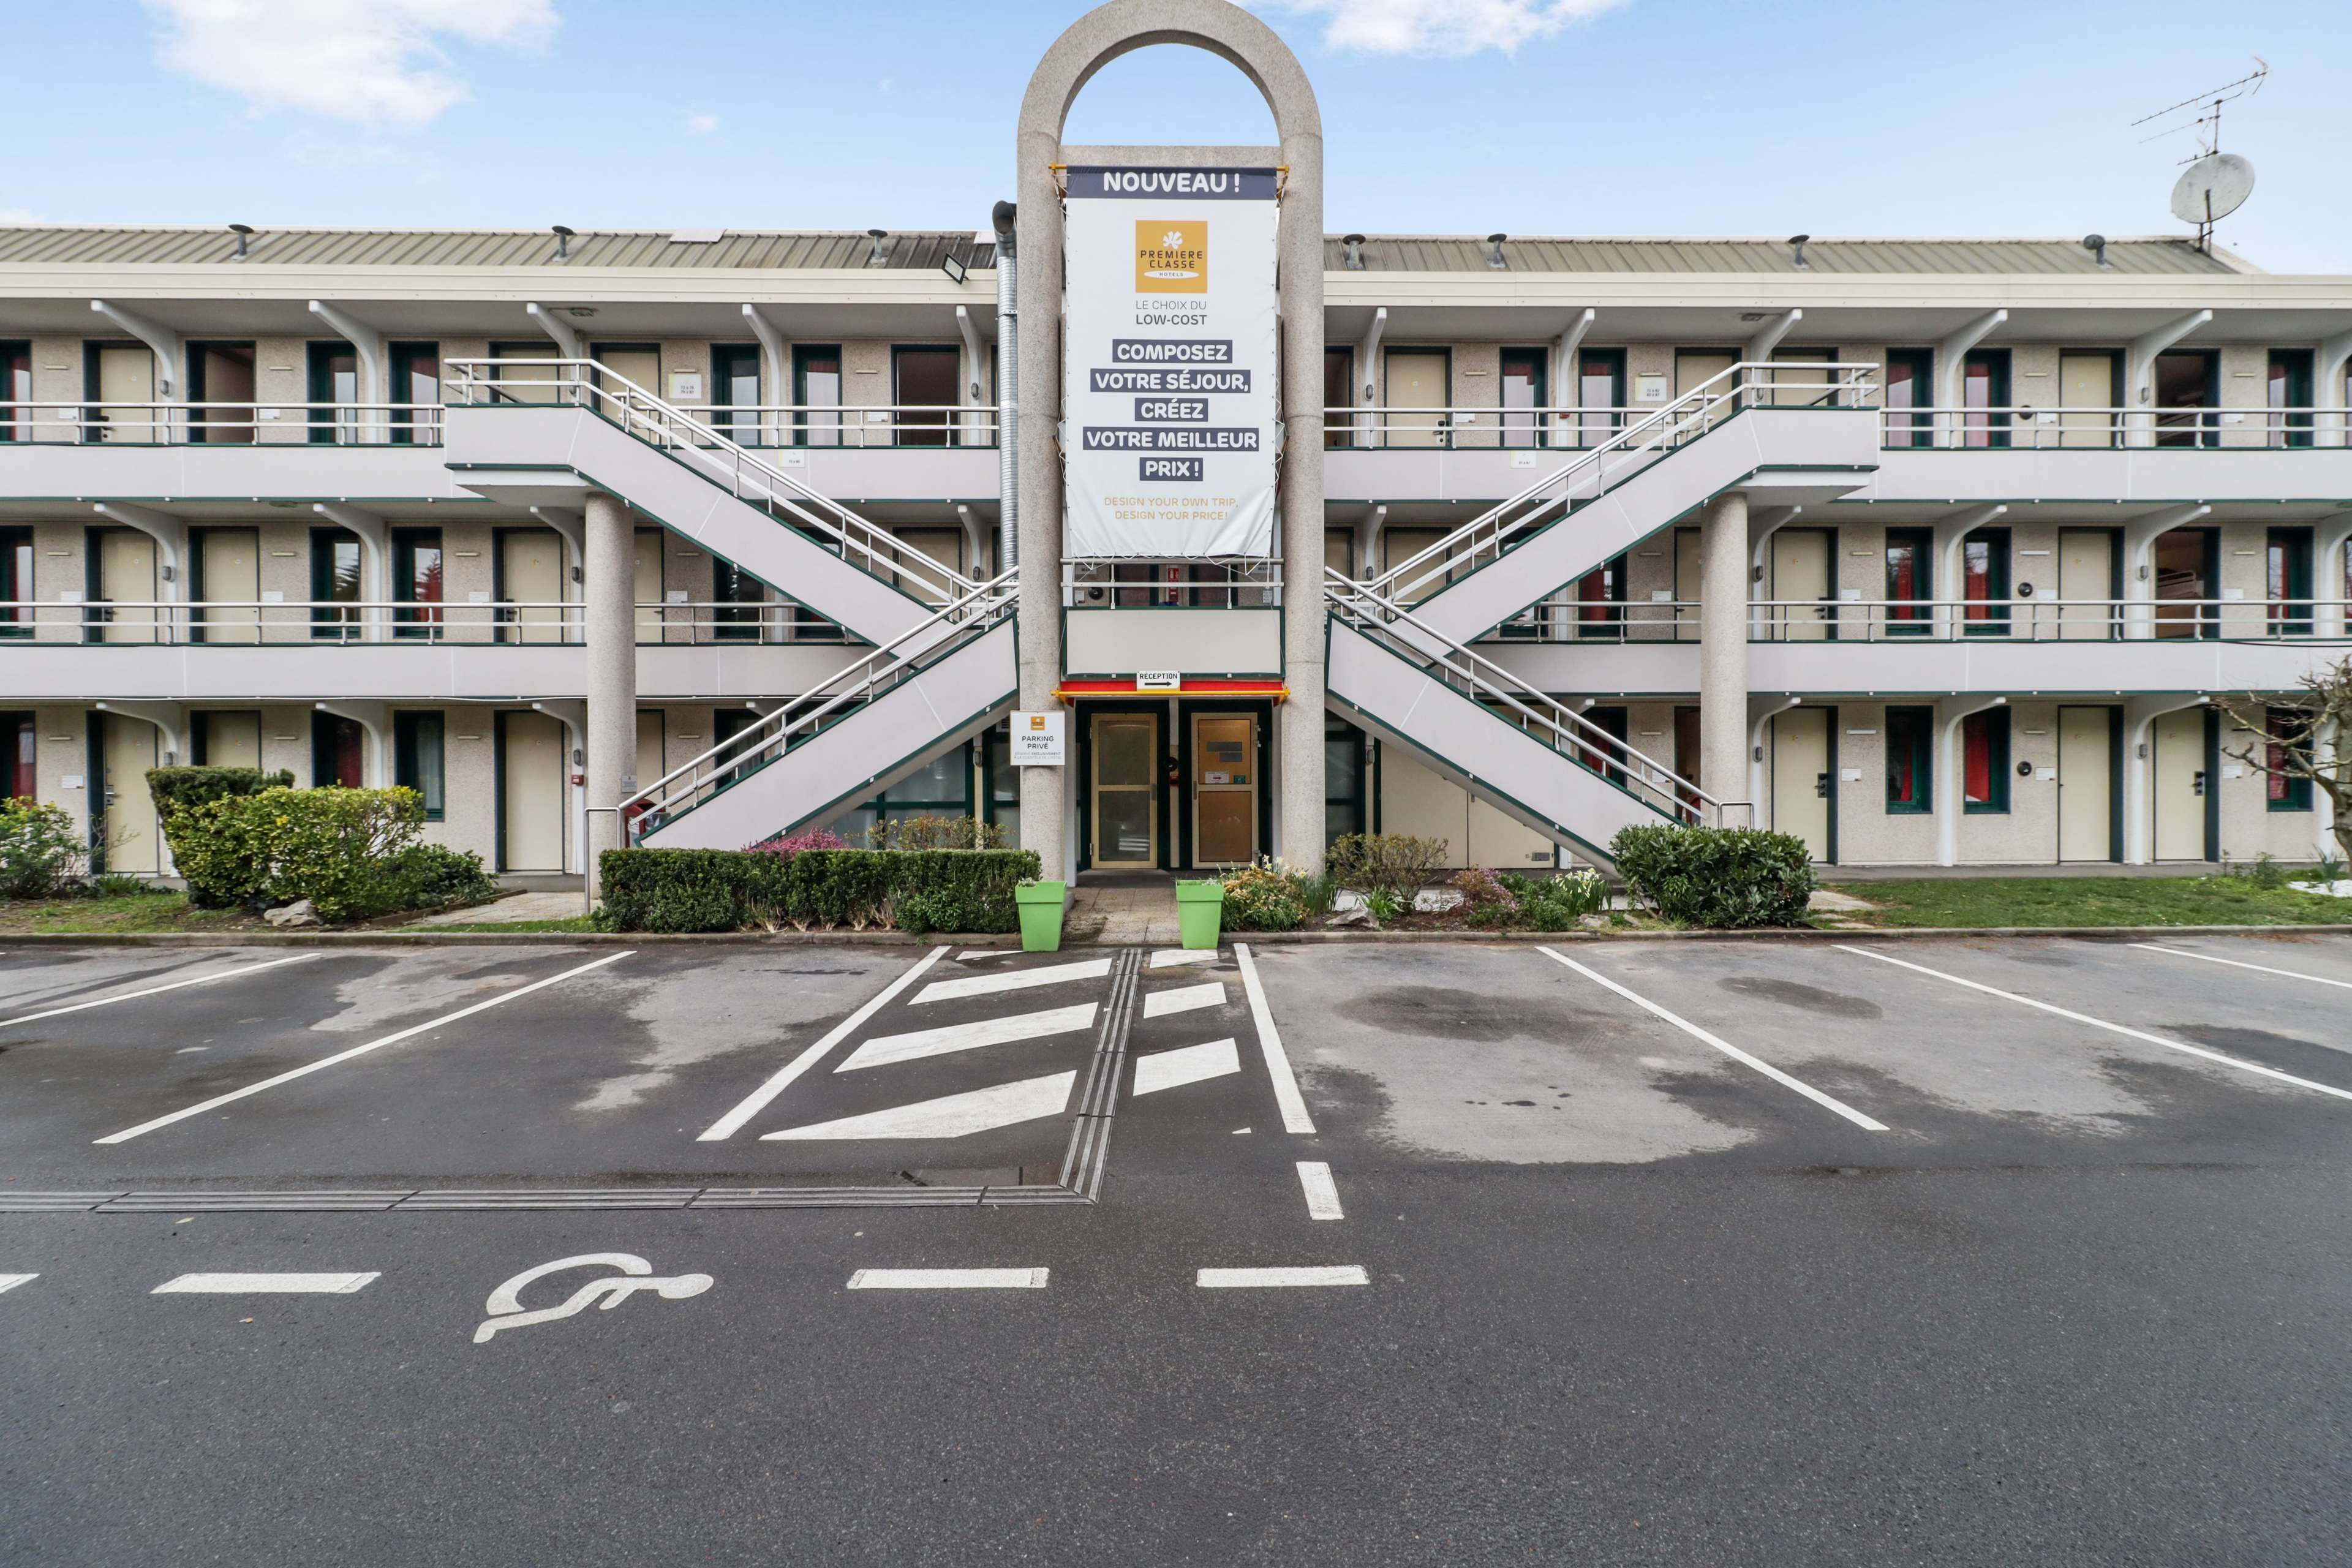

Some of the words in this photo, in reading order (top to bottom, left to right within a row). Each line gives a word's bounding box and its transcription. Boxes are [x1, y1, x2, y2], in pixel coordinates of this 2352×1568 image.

[1103, 172, 1227, 193] NOUVEAU
[1234, 173, 1240, 192] !
[1140, 250, 1203, 258] PREMIERE
[1149, 260, 1195, 268] CLASSE
[1136, 300, 1148, 310] LE
[1152, 300, 1188, 310] CHOIX
[1191, 300, 1207, 310] DU
[1136, 314, 1208, 326] LOW-COST
[1117, 344, 1227, 361] COMPOSEZ
[1095, 372, 1161, 389] VOTRE
[1166, 369, 1249, 392] SÉJOUR,
[1140, 399, 1204, 419] CRÉEZ
[1087, 430, 1153, 447] VOTRE
[1158, 431, 1257, 448] MEILLEUR
[1145, 461, 1189, 477] PRIX
[1194, 461, 1199, 477] !
[1104, 497, 1145, 507] DESIGN
[1147, 497, 1179, 507] YOUR
[1182, 497, 1208, 507] OWN
[1212, 497, 1239, 508] TRIP,
[1115, 510, 1156, 520] DESIGN
[1158, 511, 1189, 520] YOUR
[1192, 511, 1229, 520] PRICE!
